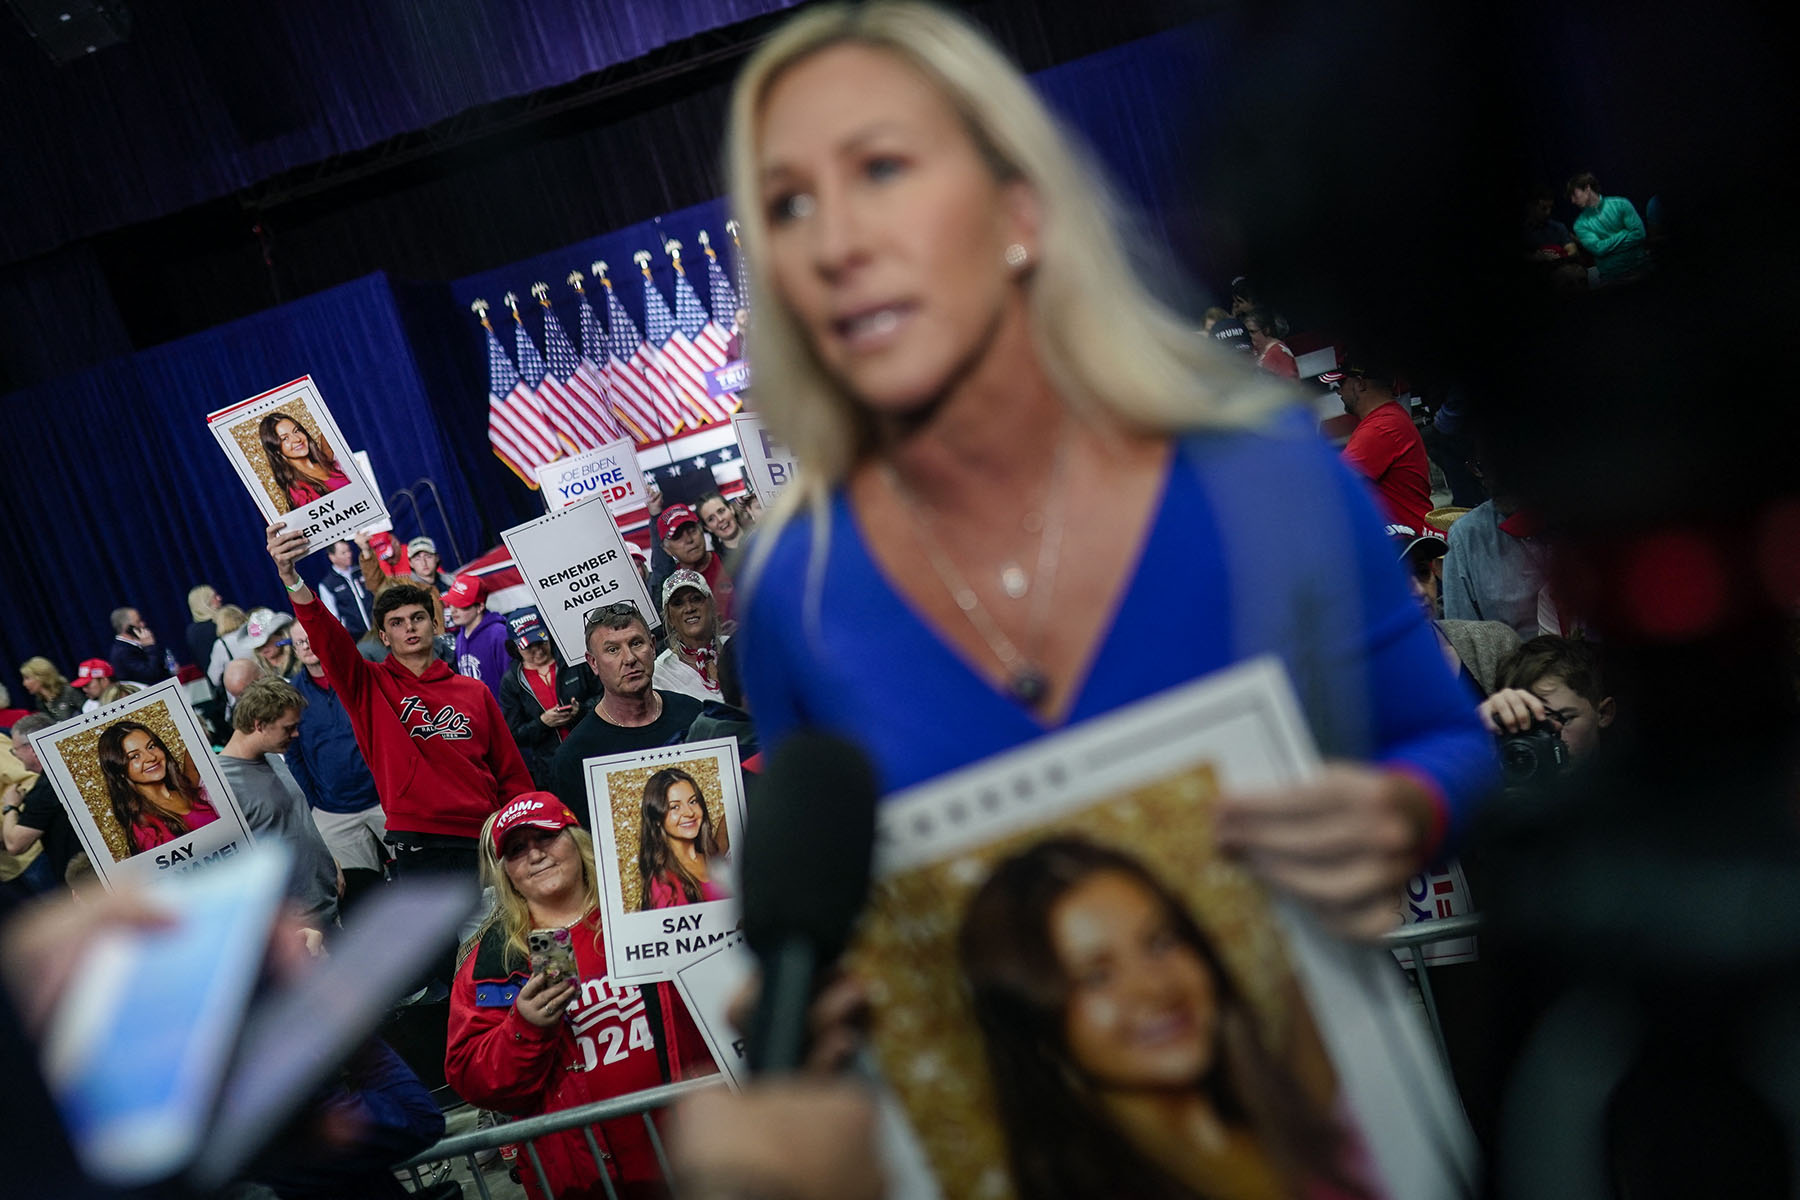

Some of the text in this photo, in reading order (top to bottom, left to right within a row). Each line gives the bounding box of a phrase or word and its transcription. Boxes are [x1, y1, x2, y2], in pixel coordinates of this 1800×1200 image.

[1215, 327, 1244, 340] TRUMP
[559, 467, 580, 484] JOE
[559, 467, 625, 499] YOU'RE
[303, 500, 371, 539] ER NAME!
[308, 500, 336, 520] SAY
[538, 549, 618, 590] REMEMBER
[568, 572, 601, 592] OUR
[563, 579, 620, 611] ANGELS
[509, 612, 538, 629] Trump
[496, 799, 545, 829] TRUMP
[155, 841, 194, 871] SAY
[662, 913, 704, 935] SAY
[625, 929, 737, 962] HER NAM
[576, 1014, 655, 1073] 024
